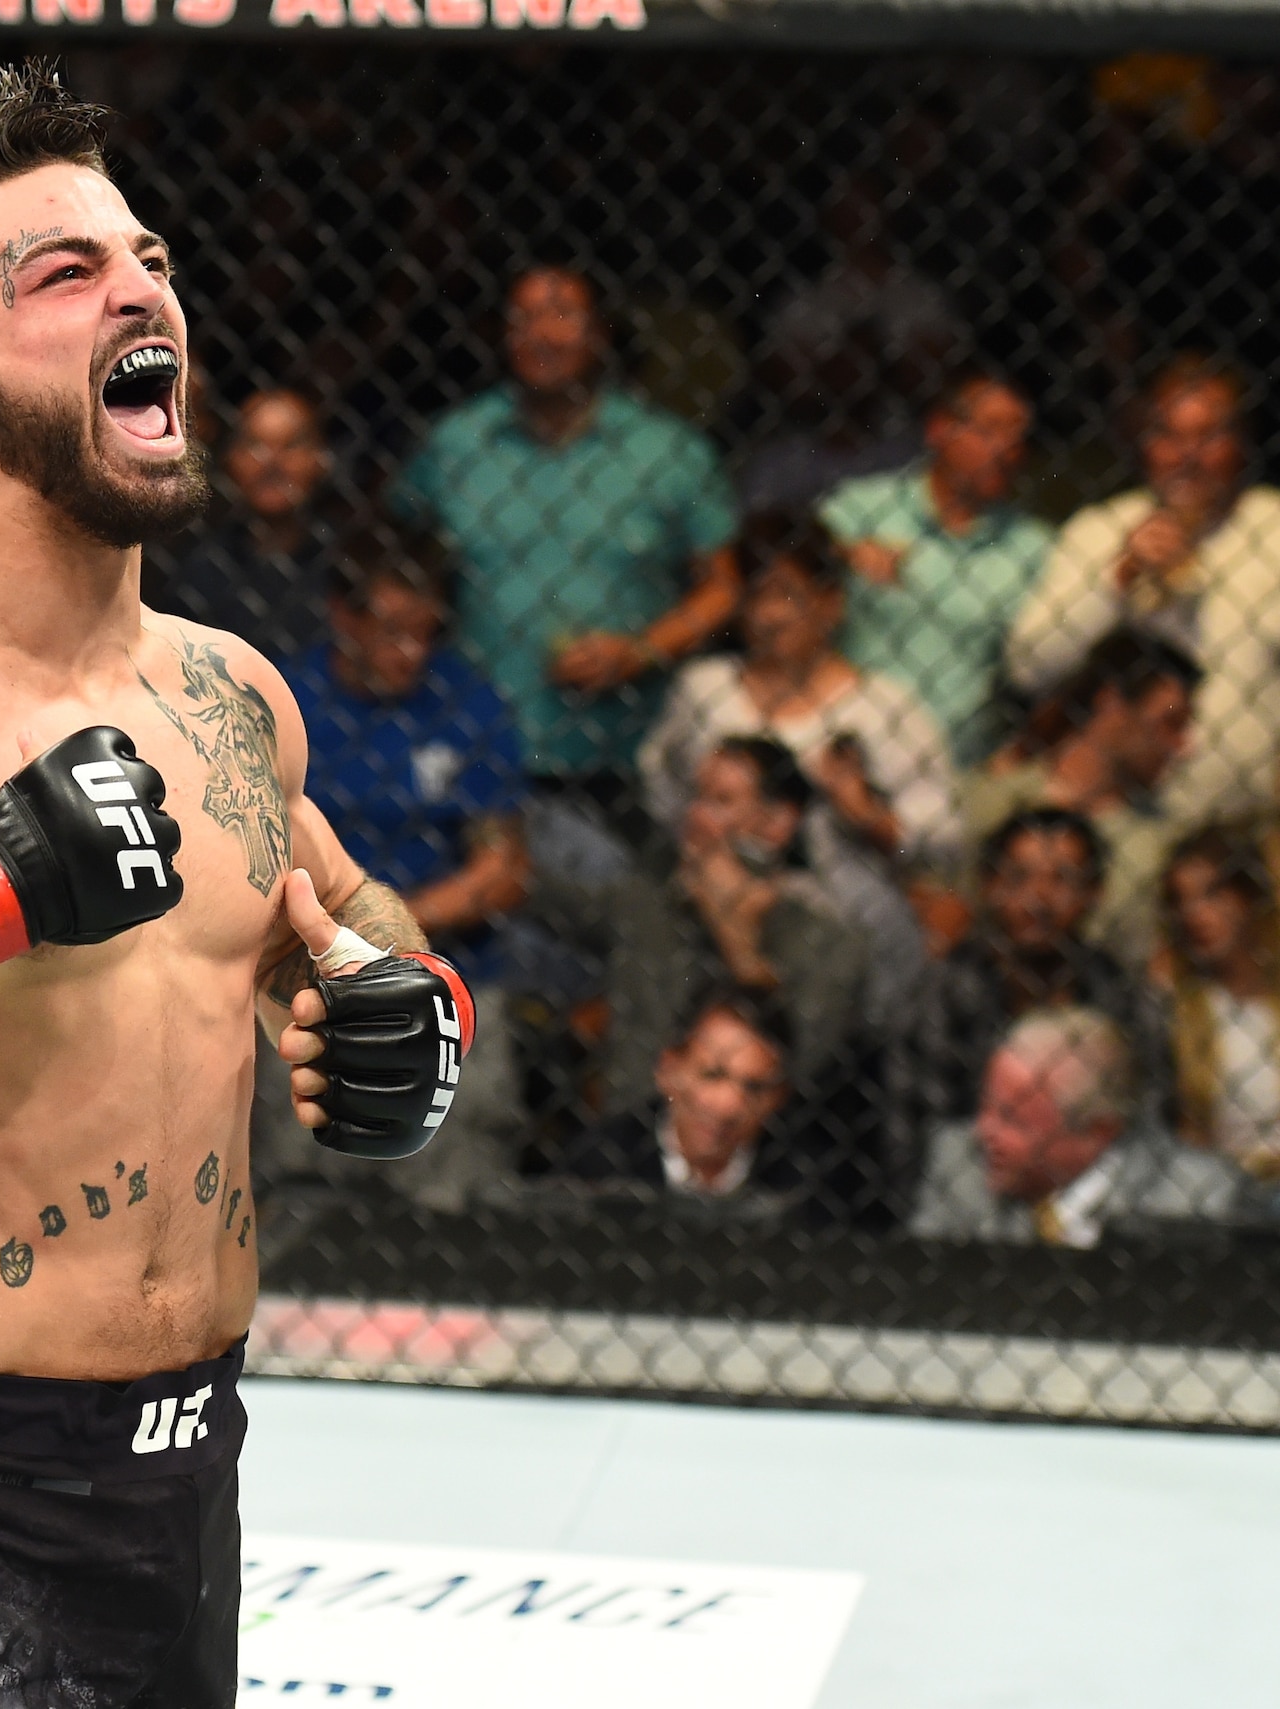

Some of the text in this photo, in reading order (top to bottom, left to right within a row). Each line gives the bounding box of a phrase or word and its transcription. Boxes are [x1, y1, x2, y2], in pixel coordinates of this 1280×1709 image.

[71, 760, 168, 889] UFC
[221, 785, 265, 813] Mike
[422, 995, 461, 1128] UFC
